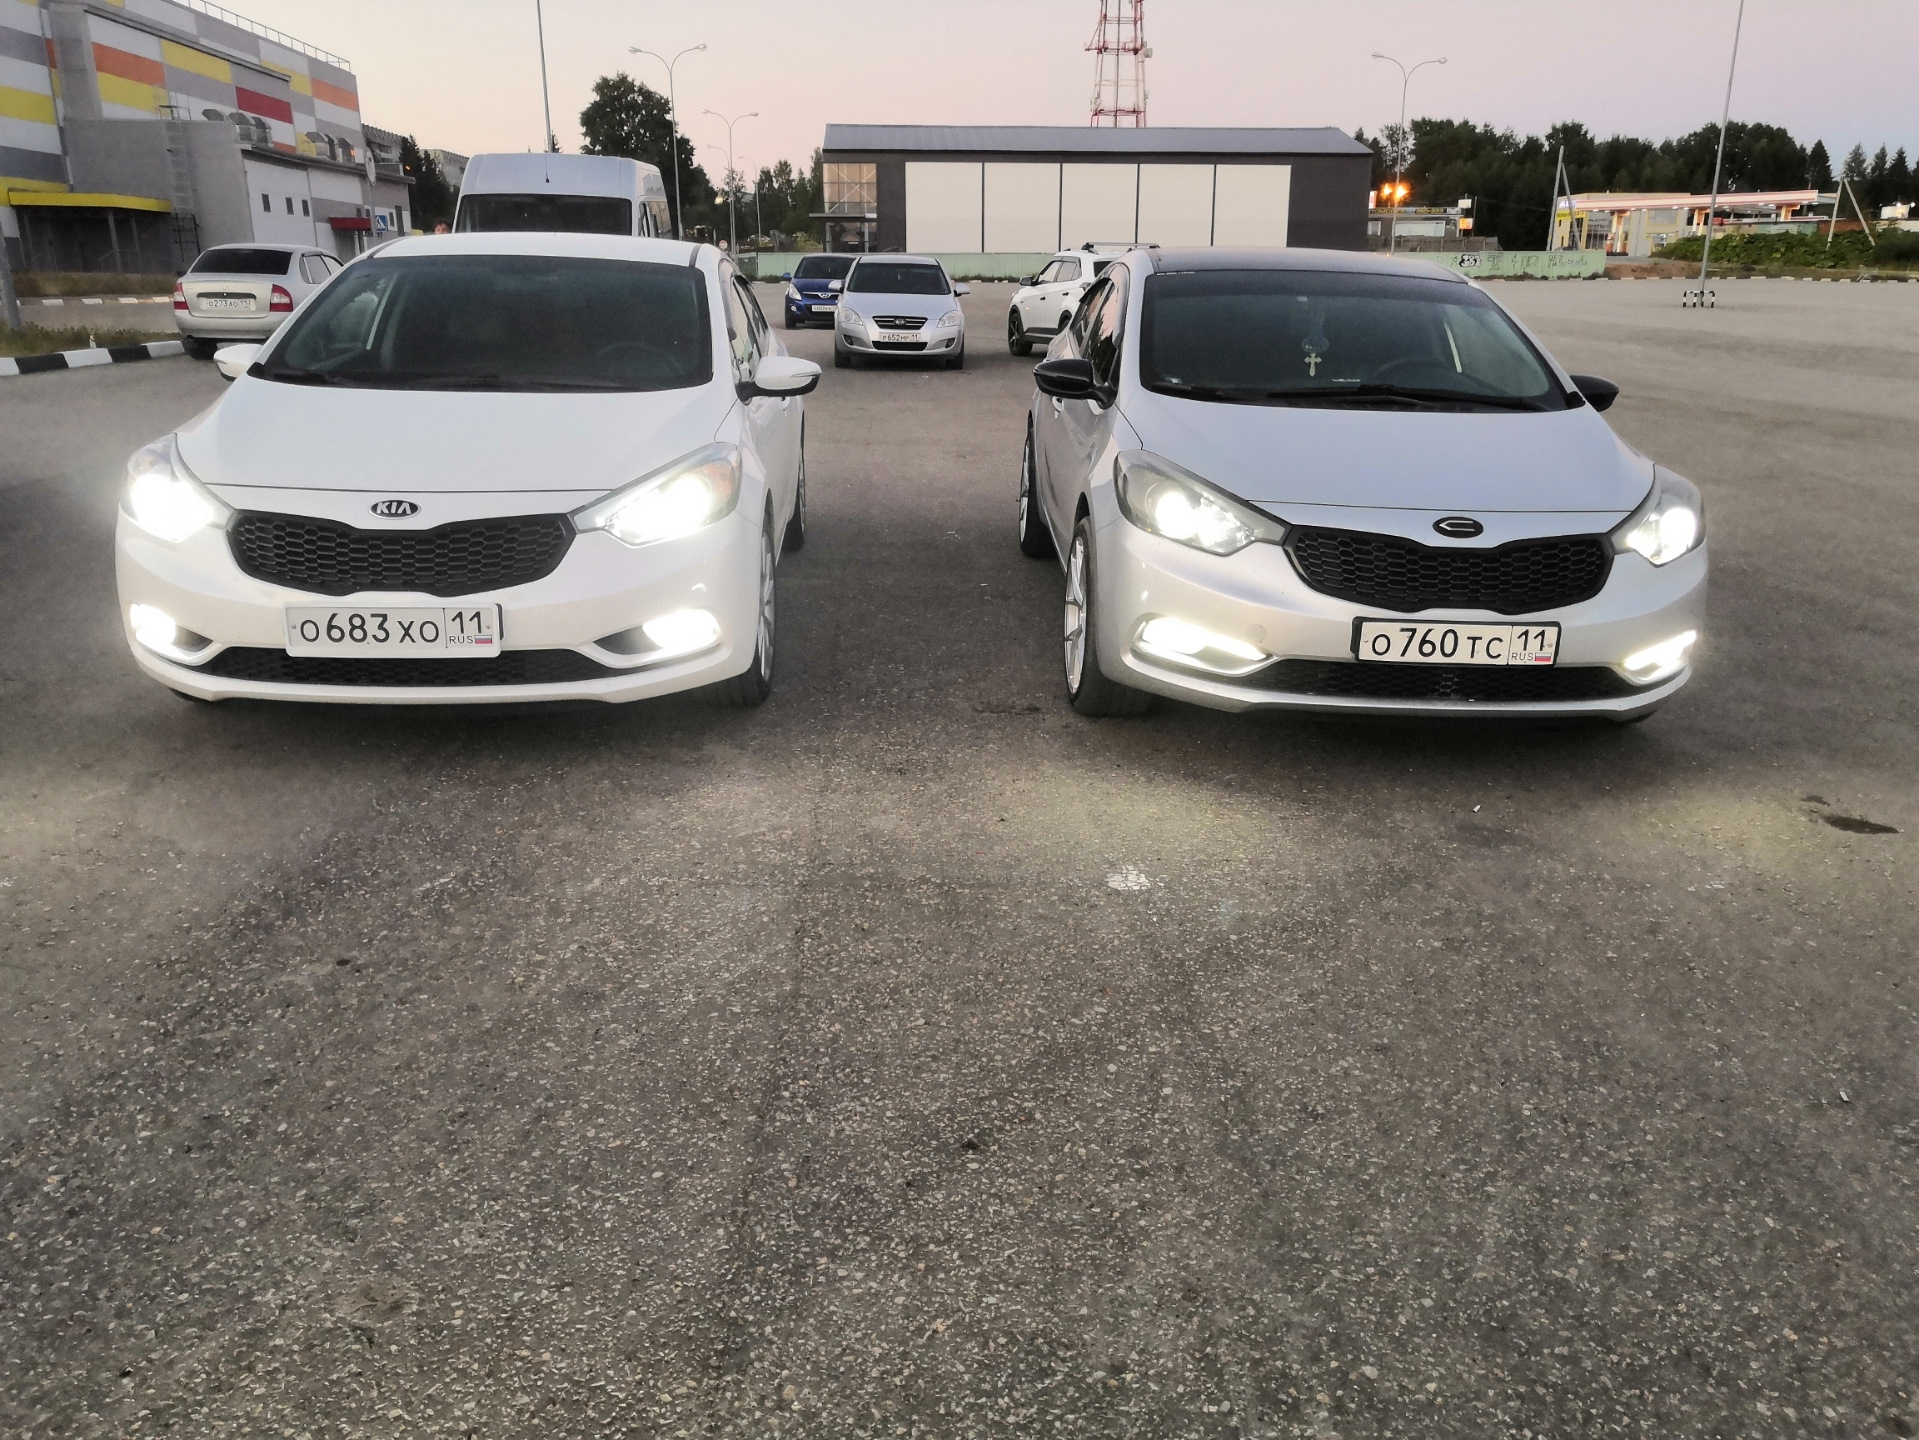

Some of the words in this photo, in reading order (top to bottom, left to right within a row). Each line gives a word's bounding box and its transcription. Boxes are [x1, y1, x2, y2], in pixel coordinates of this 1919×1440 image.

[376, 501, 412, 515] KIA
[300, 612, 440, 644] О683ХО
[450, 610, 482, 634] 11
[449, 635, 474, 644] RUS
[1371, 627, 1504, 660] О760ТС
[1516, 628, 1547, 652] 11
[1511, 652, 1534, 662] RUS
